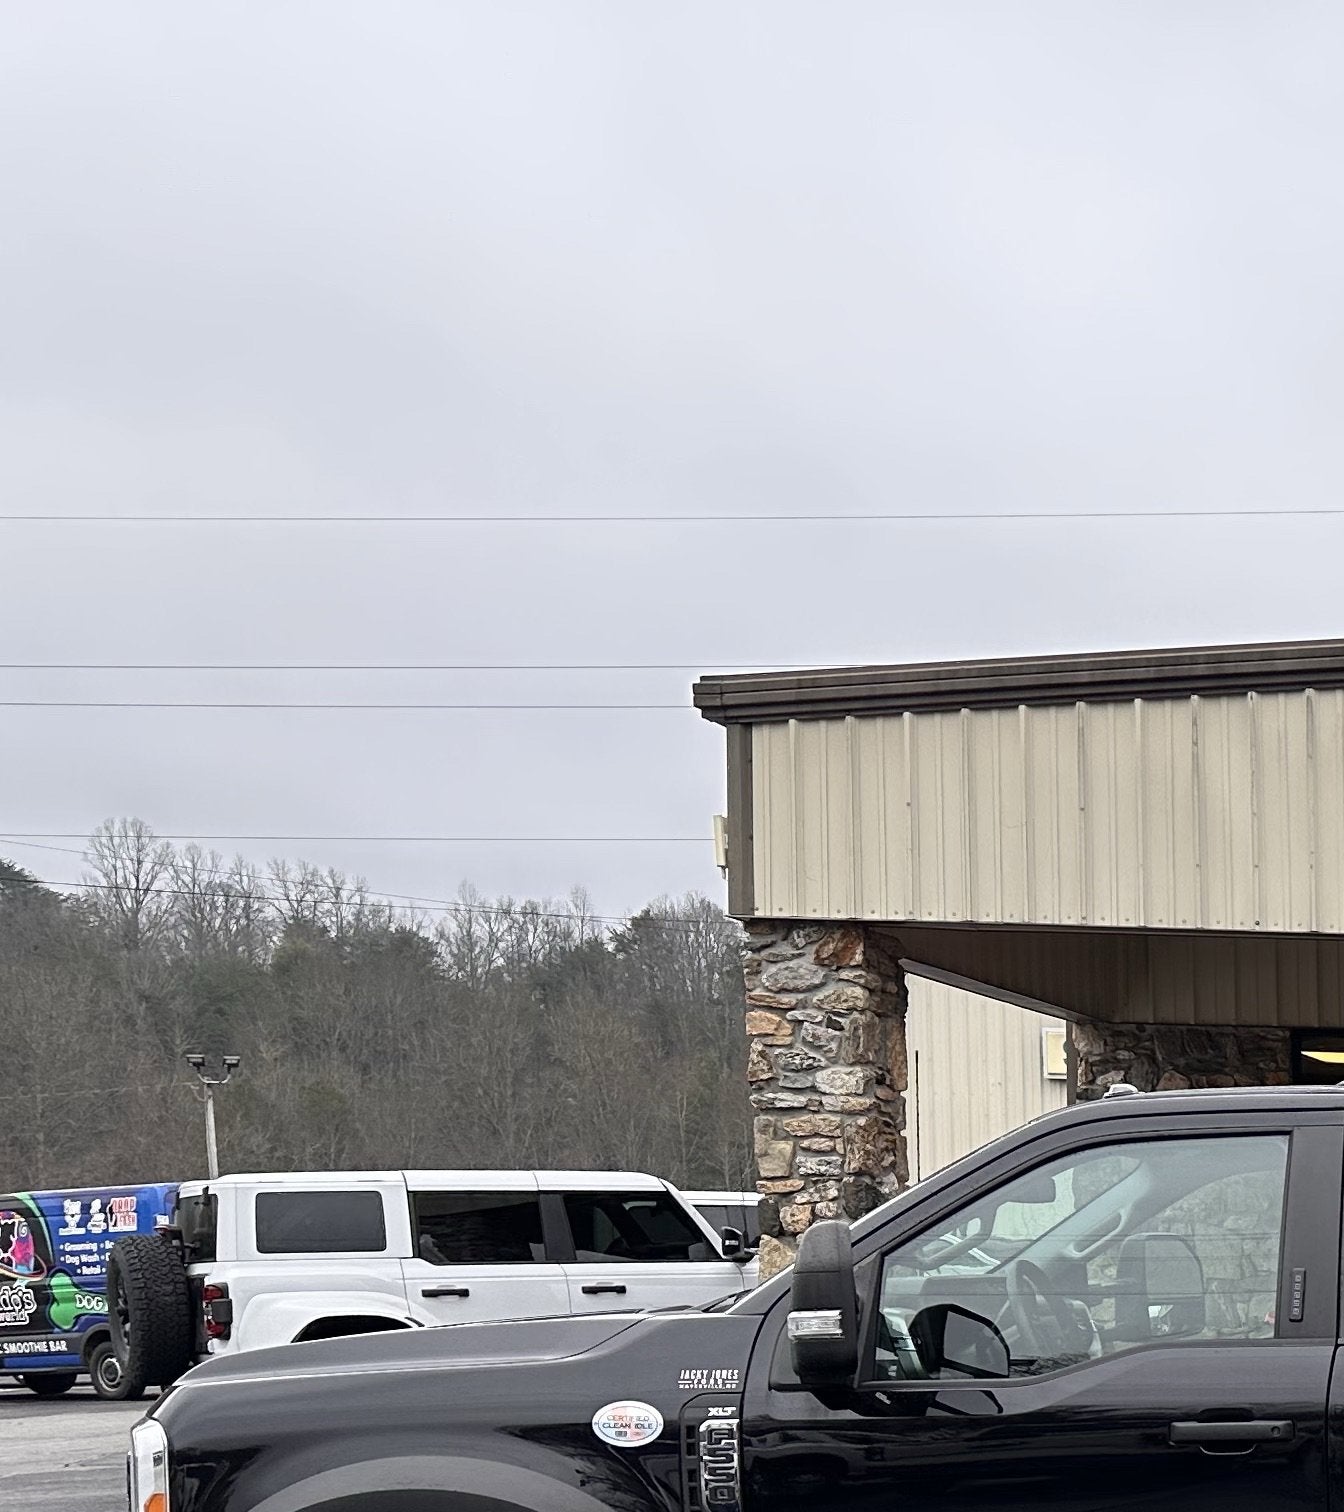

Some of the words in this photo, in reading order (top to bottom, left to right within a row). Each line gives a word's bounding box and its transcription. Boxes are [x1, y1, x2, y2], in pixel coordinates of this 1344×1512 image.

[65, 1254, 79, 1266] Dog
[0, 1290, 34, 1311] do's
[74, 1293, 104, 1311] DOG
[3, 1341, 49, 1354] SMOOTHIE
[49, 1340, 68, 1352] BAR
[680, 1369, 709, 1380] JACKY
[711, 1369, 739, 1380] JONES
[707, 1406, 737, 1417] XLT
[606, 1414, 650, 1422] CERTIFIED
[602, 1422, 632, 1430] CLEAN
[634, 1422, 654, 1430] IDLE
